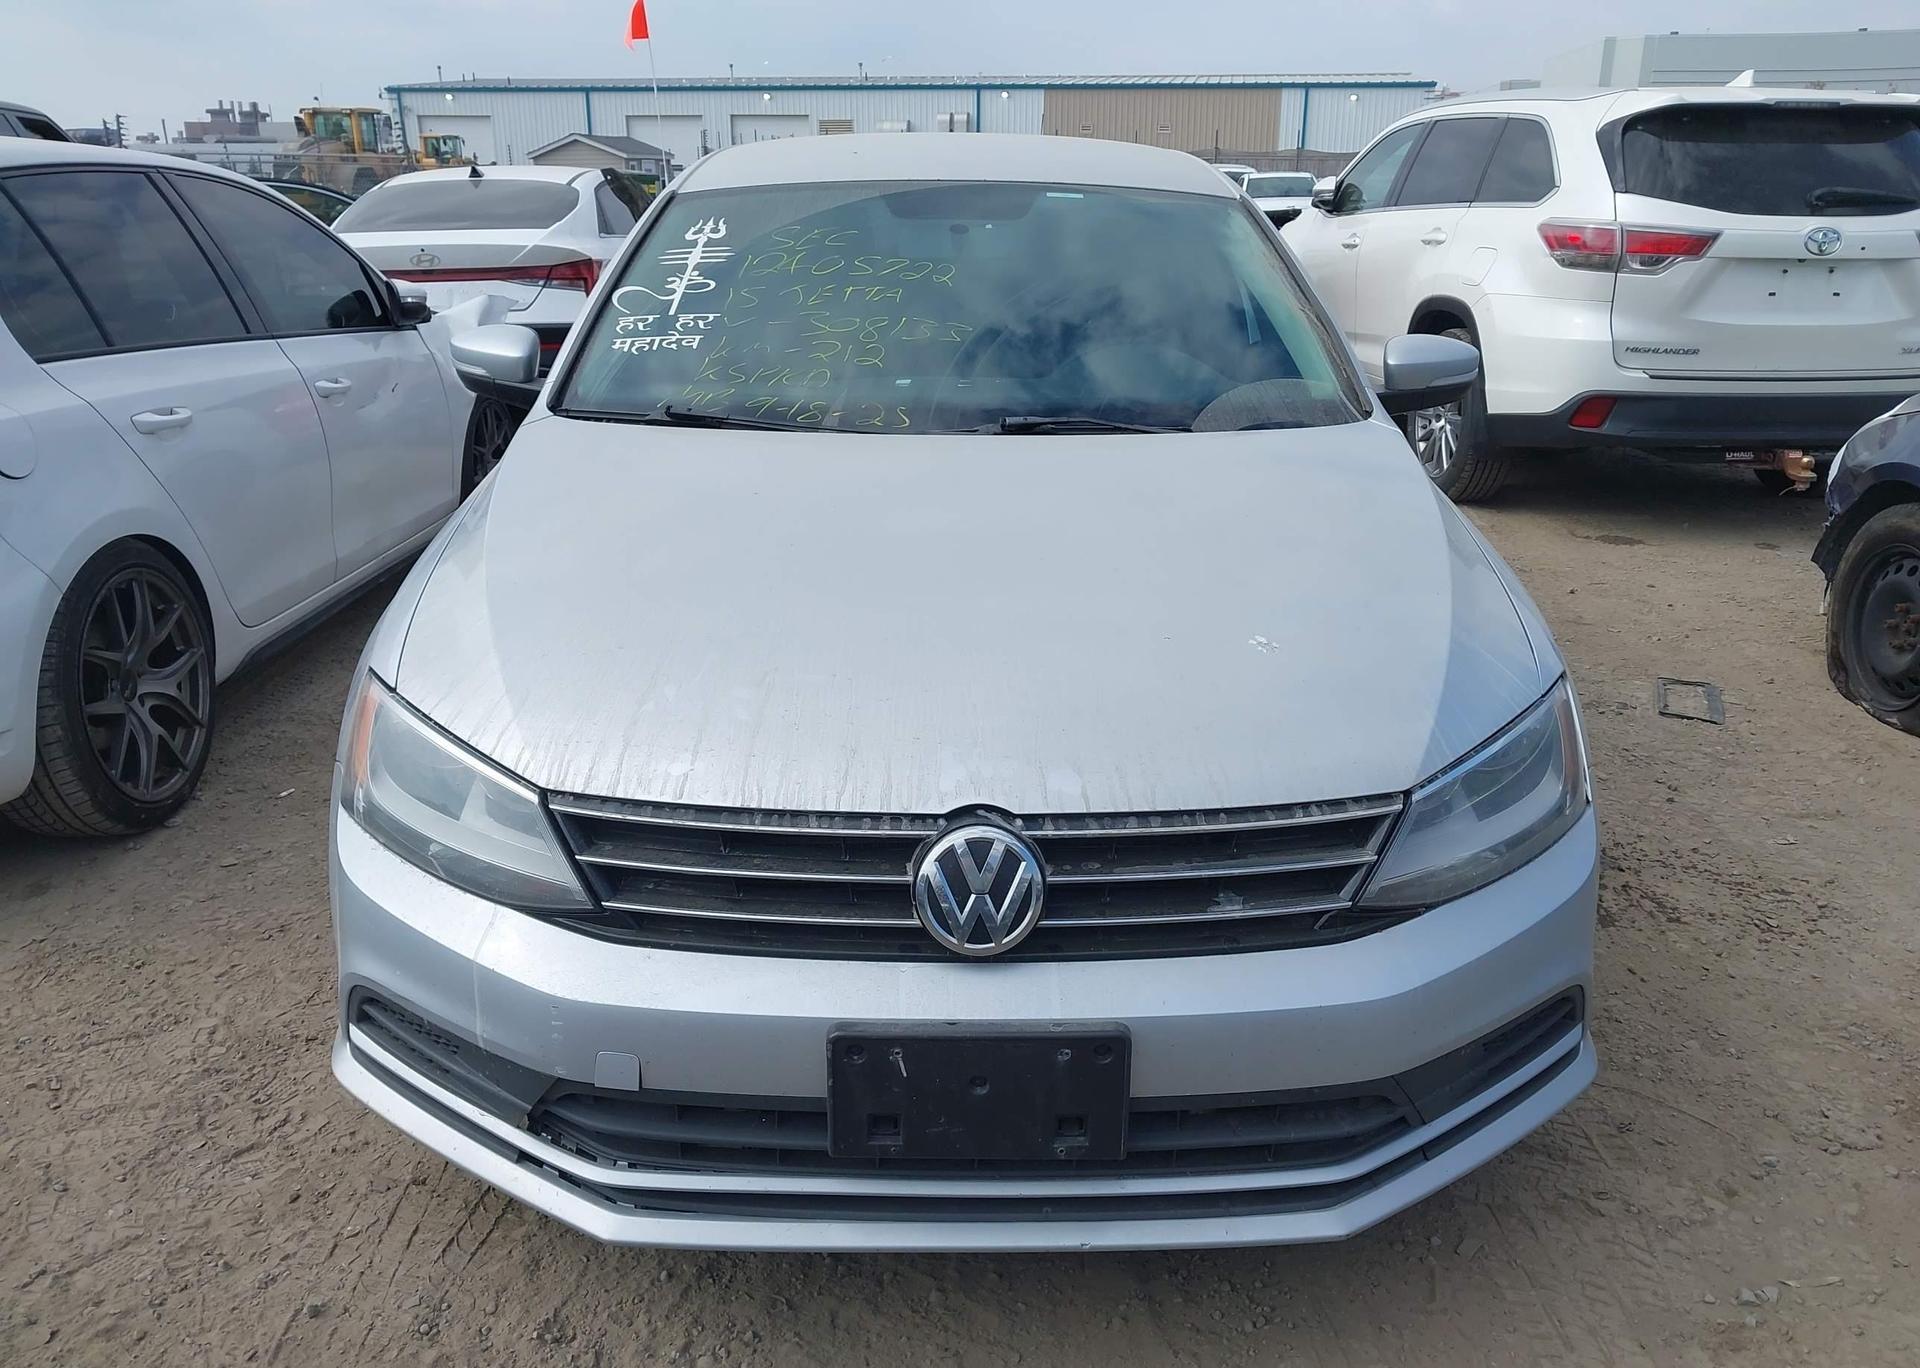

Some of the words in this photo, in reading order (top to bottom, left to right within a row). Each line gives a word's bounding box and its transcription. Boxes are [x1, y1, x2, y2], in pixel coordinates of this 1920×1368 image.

[615, 314, 661, 335] हर
[675, 313, 722, 332] हर
[611, 331, 704, 355] महादेव
[1624, 346, 1700, 355] HIGHLANDER
